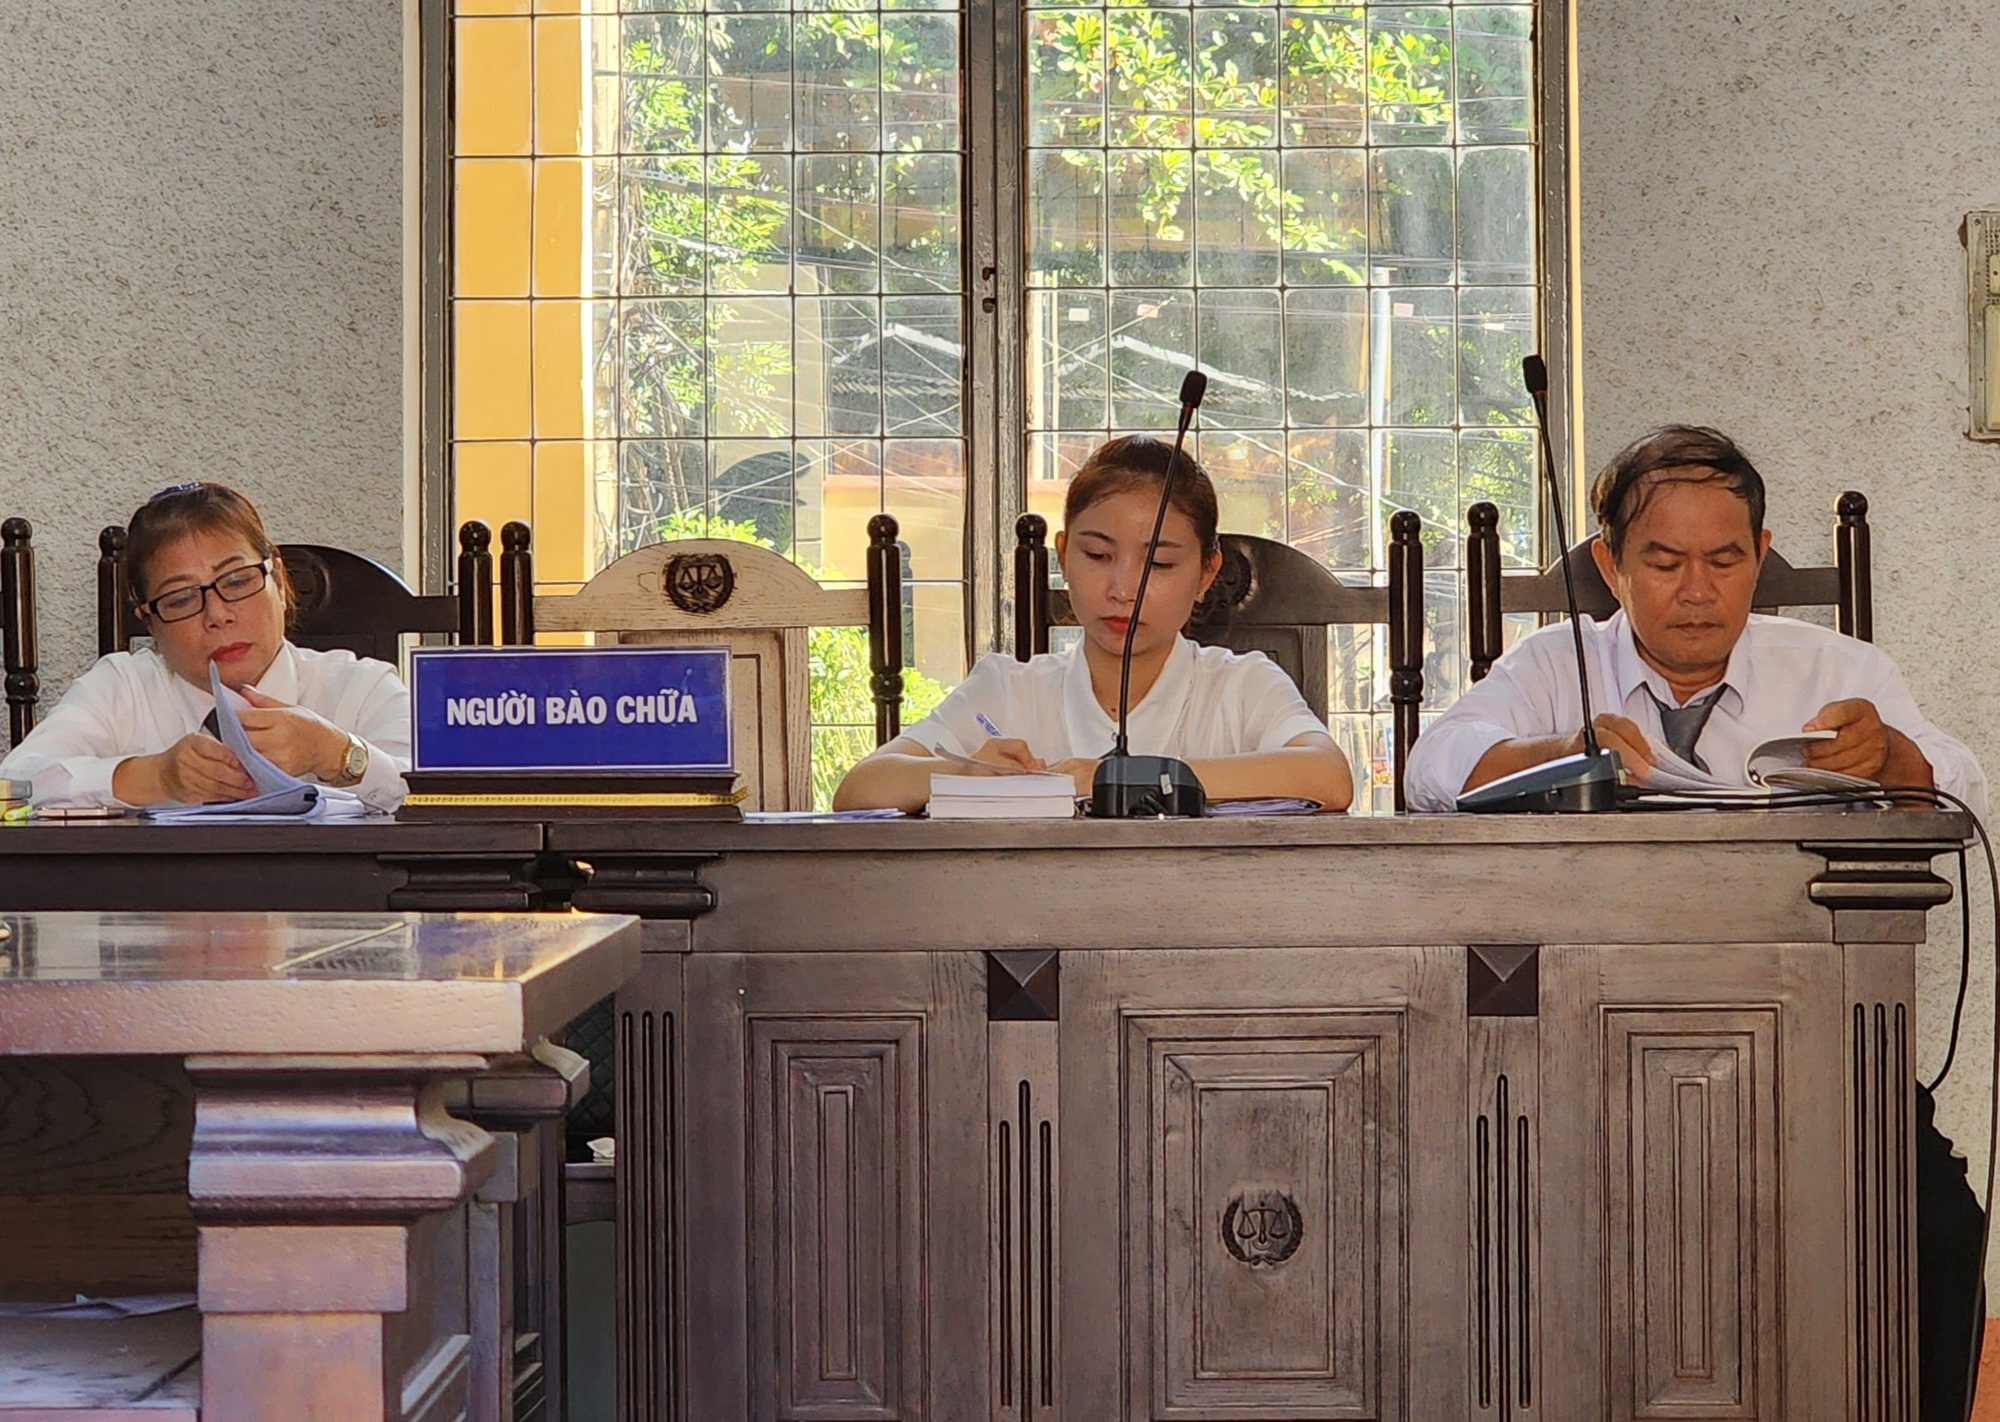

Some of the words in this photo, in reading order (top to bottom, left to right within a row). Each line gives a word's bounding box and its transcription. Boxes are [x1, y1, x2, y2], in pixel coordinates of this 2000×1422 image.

[447, 690, 535, 726] NGƯỜI
[546, 689, 607, 725] BÀO
[616, 688, 698, 724] CHỮA
